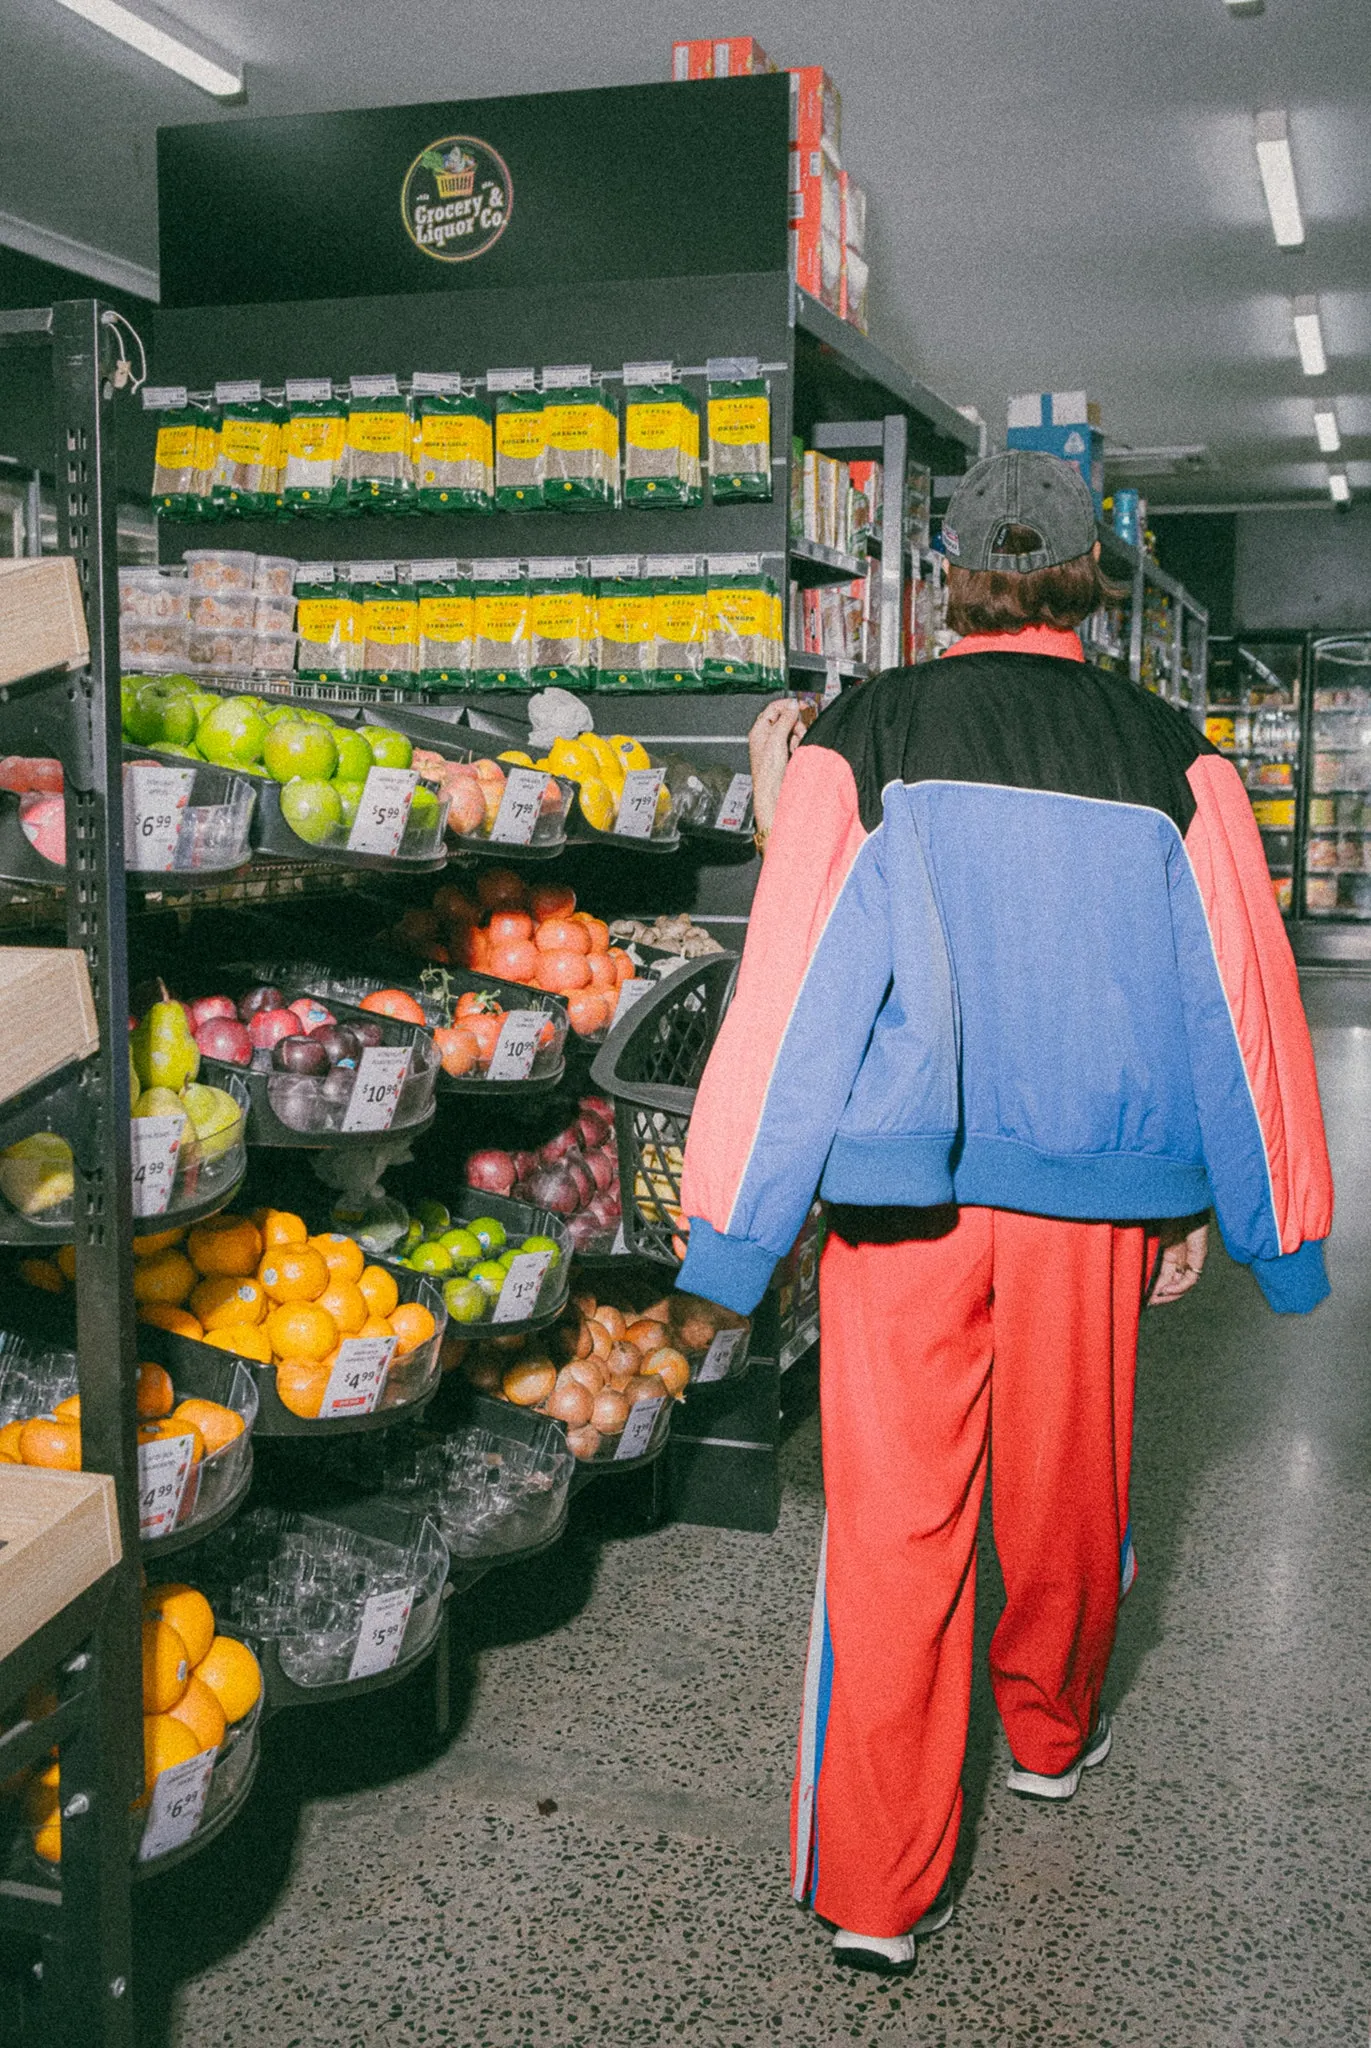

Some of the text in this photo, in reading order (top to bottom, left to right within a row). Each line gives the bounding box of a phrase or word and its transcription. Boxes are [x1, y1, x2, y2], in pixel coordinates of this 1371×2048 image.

[415, 186, 503, 224] Grocery &
[416, 217, 475, 247] Liquor
